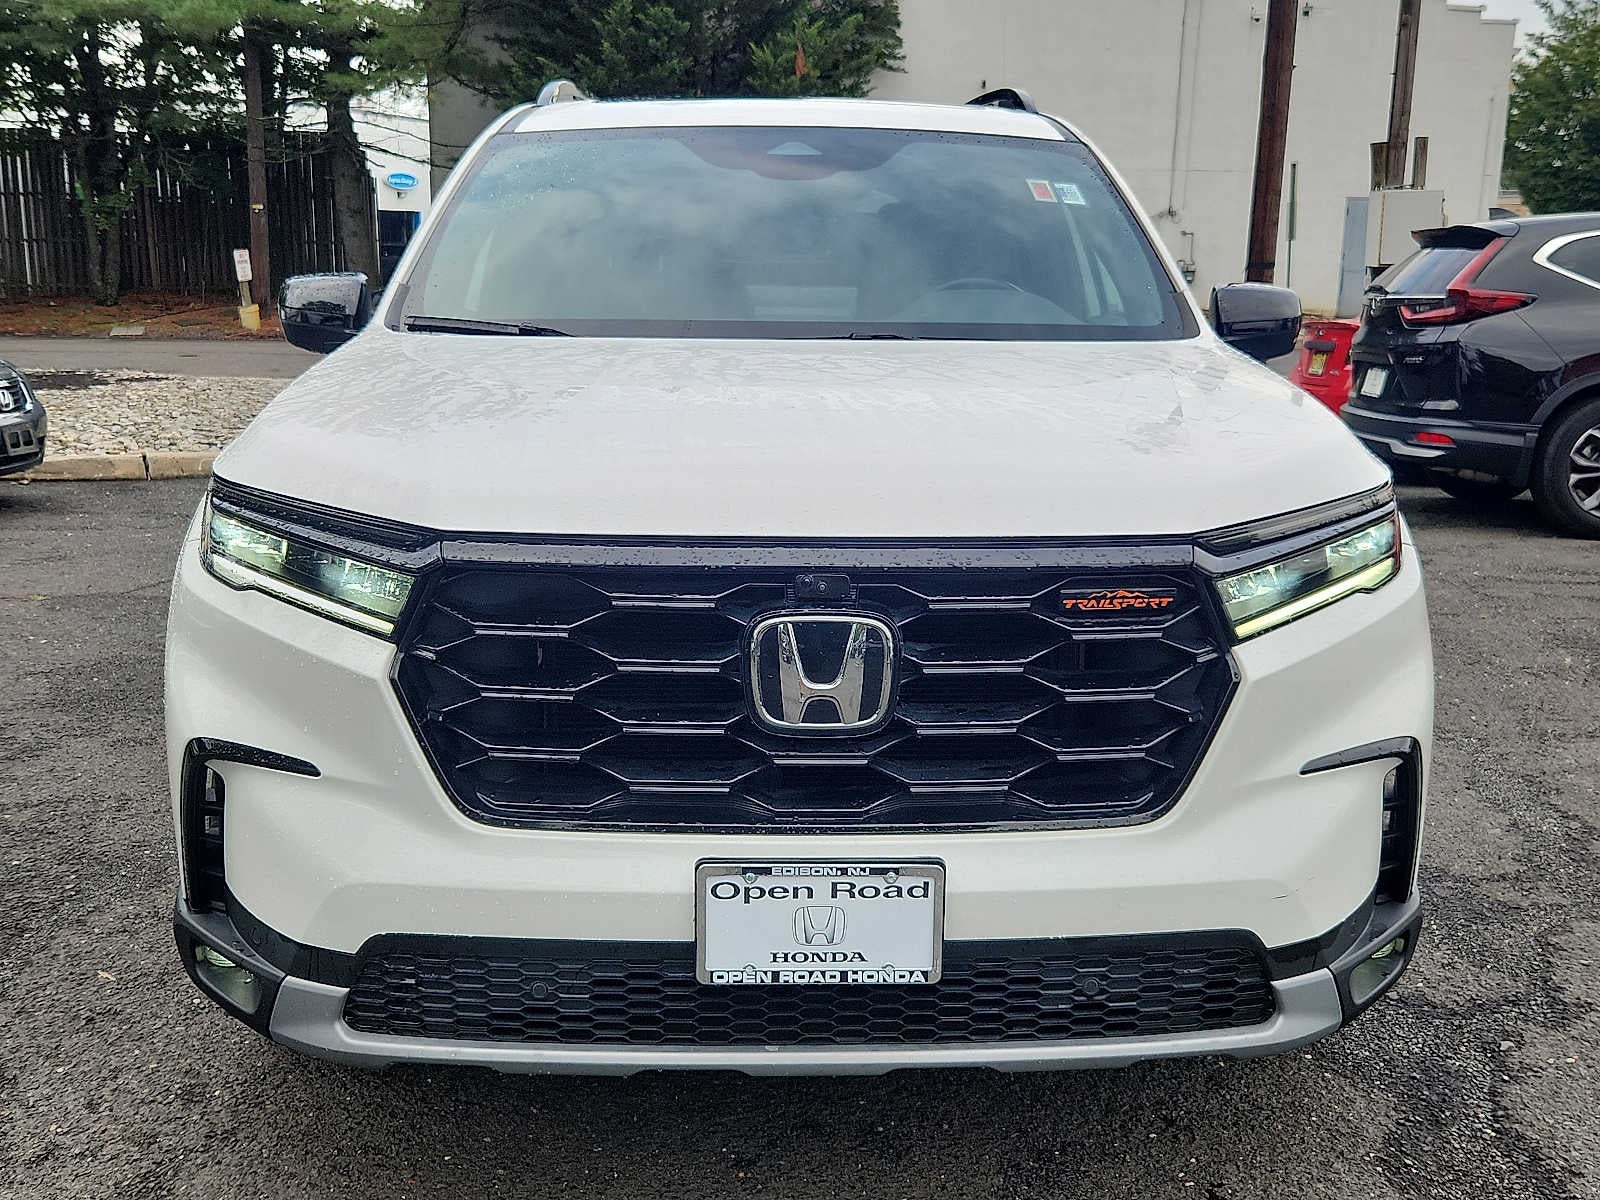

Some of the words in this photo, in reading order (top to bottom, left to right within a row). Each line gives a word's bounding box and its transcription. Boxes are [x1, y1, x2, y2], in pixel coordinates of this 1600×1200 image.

[1062, 598, 1174, 610] TRAILSPORT
[847, 867, 870, 876] NJ
[710, 881, 814, 904] Open
[830, 881, 930, 899] Road
[769, 951, 868, 963] HONDA
[712, 971, 772, 983] OPEN
[779, 971, 840, 983] ROAD
[847, 971, 926, 983] HONDA
